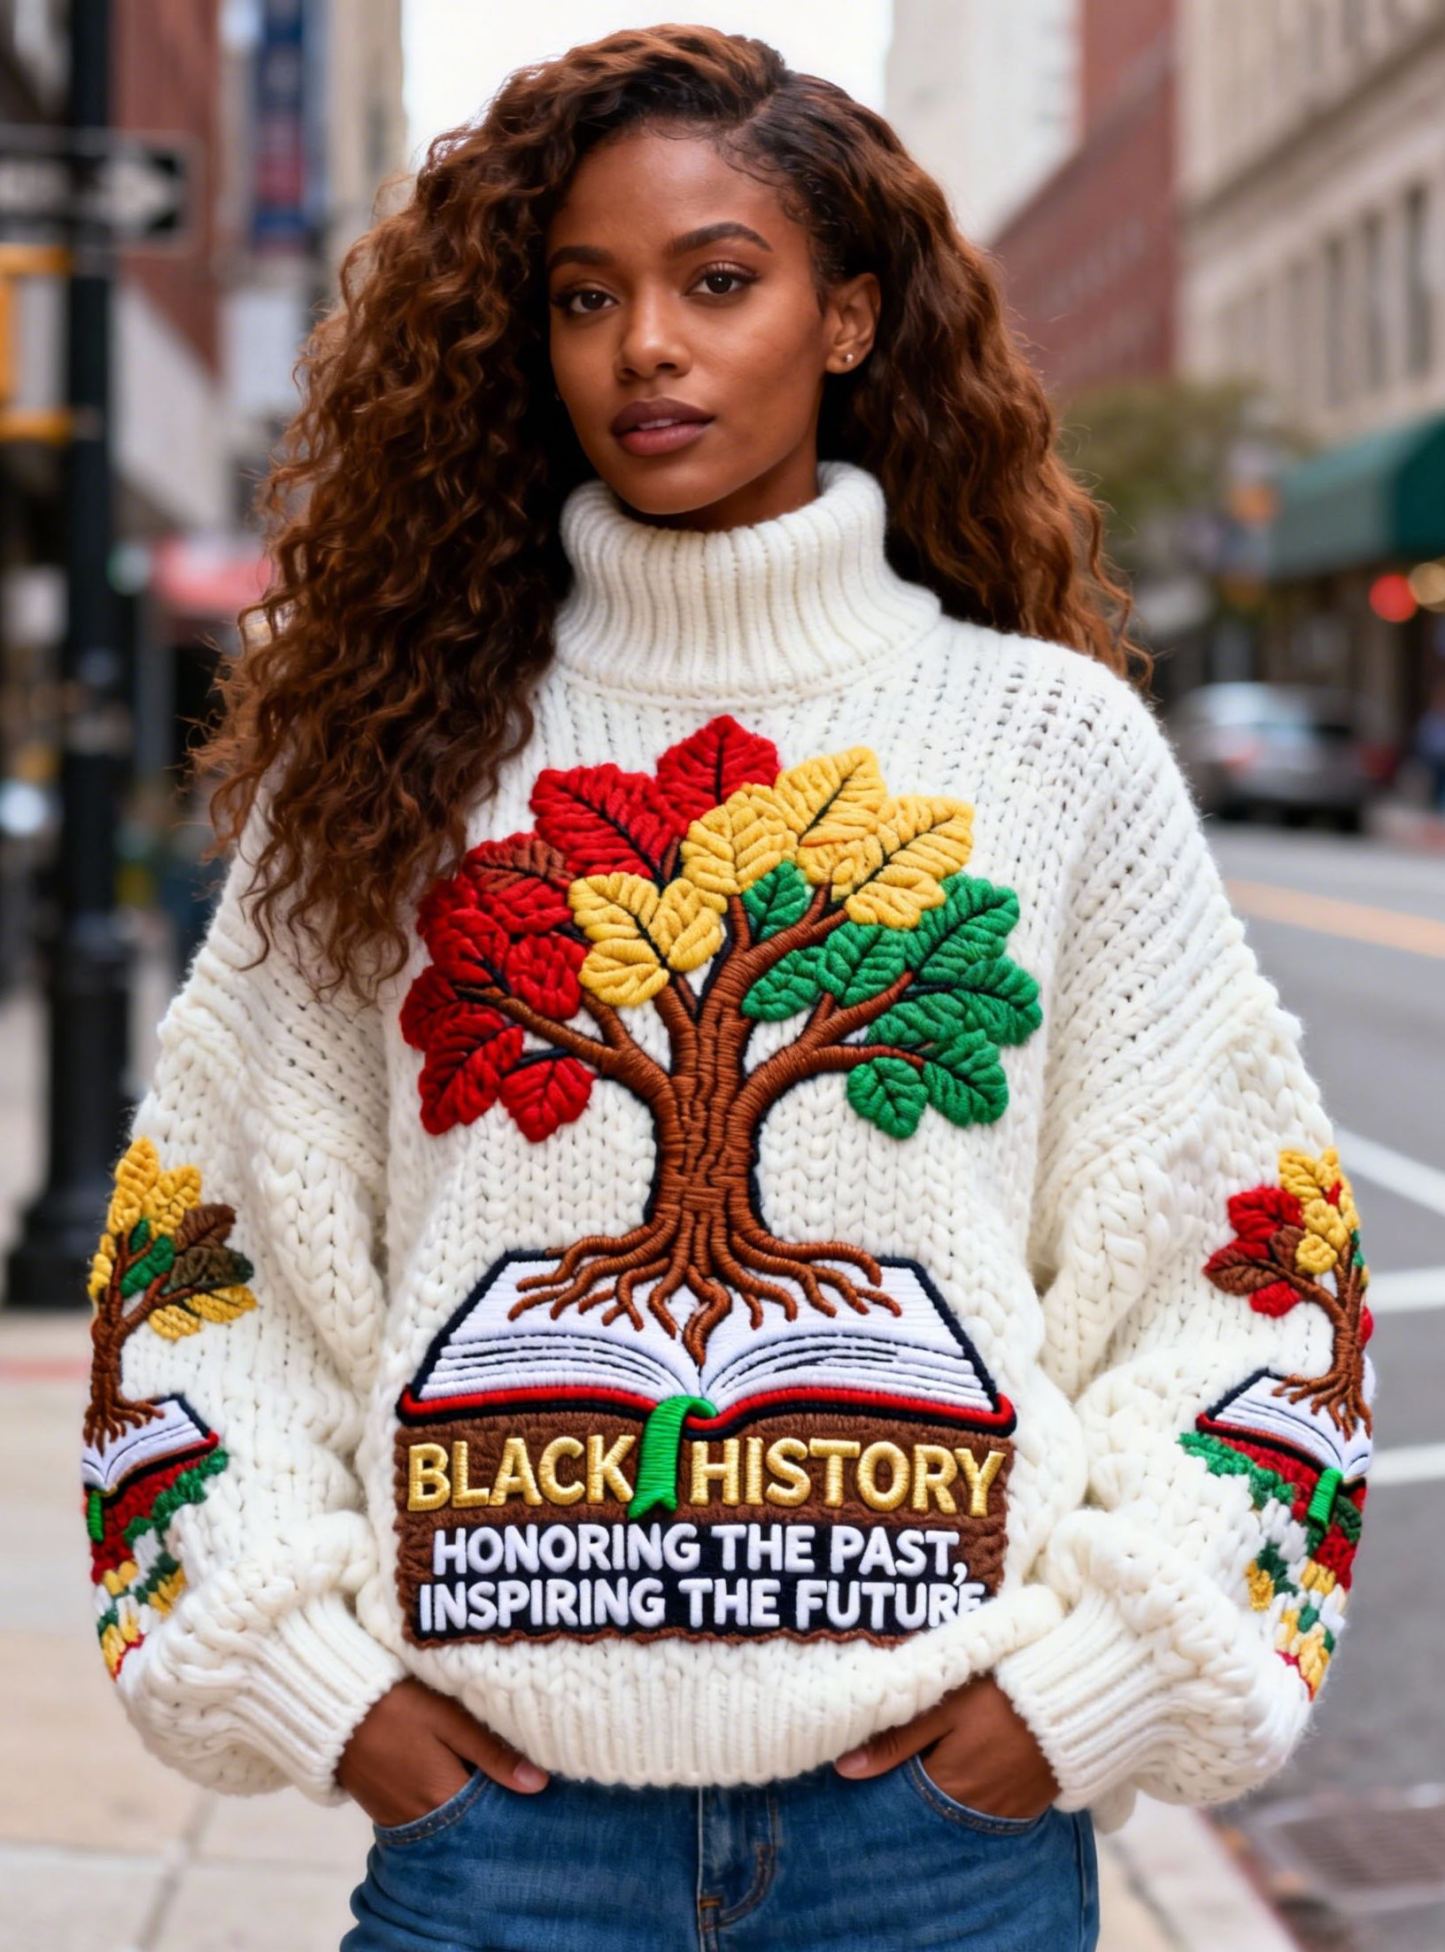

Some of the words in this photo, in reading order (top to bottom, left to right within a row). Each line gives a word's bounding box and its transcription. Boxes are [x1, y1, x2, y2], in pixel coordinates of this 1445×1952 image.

[408, 1435, 636, 1512] BLACK
[690, 1437, 1005, 1517] HISTORY
[433, 1523, 701, 1576] HONORING
[711, 1524, 816, 1571] THE
[831, 1526, 968, 1586] PAST,
[420, 1577, 665, 1632] INSPIRING
[678, 1578, 781, 1628] THE
